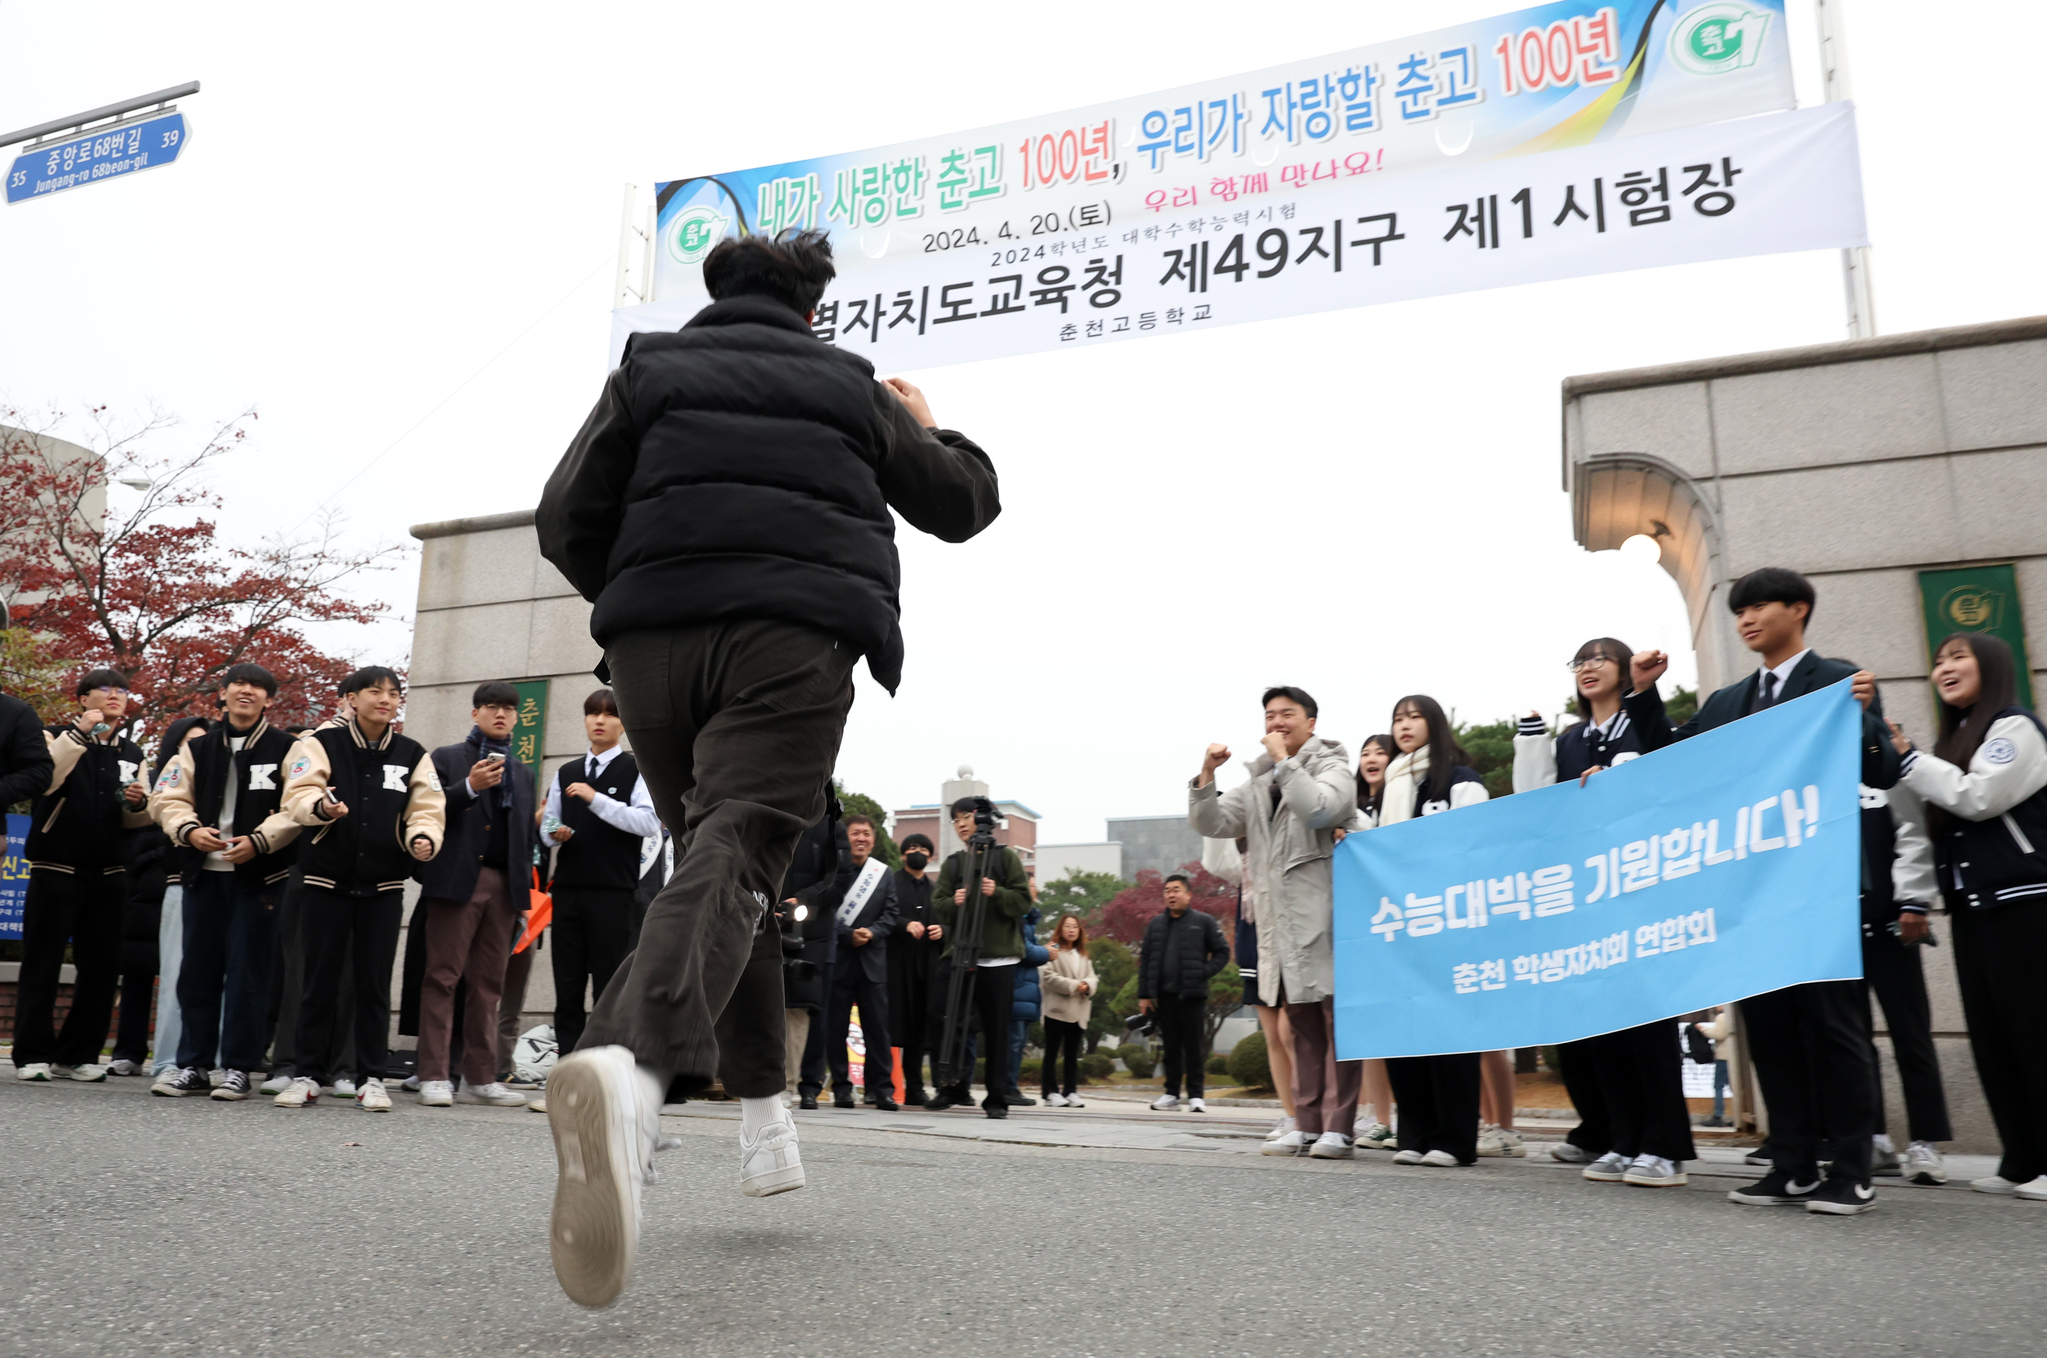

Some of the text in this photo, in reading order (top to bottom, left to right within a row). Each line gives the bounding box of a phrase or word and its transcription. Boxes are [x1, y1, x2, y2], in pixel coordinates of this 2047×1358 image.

[161, 129, 180, 149] 39
[758, 10, 1618, 236] 내가 사랑한 춘고 100년, 우리가 자랑할 춘고 100년
[33, 151, 148, 194] Jungang-ro 68beon-gil
[46, 127, 142, 176] 중앙로68번길
[11, 170, 27, 188] 35
[1143, 147, 1385, 213] 우리 함께 만나요!
[923, 200, 1112, 253] 2024. 4. 20.(토)
[990, 202, 1298, 267] 2024학년도 대학수학능력시험
[1159, 212, 1406, 294] 제49지구
[1443, 157, 1743, 249] 제1시험장
[1058, 304, 1214, 342] 춘천고등학교
[117, 760, 138, 782] K
[249, 764, 277, 790] K
[383, 765, 409, 793] K
[1369, 784, 1820, 942] 수능대박을 기원합니다!
[1452, 907, 1718, 995] 춘천 학생자치회 연합회
